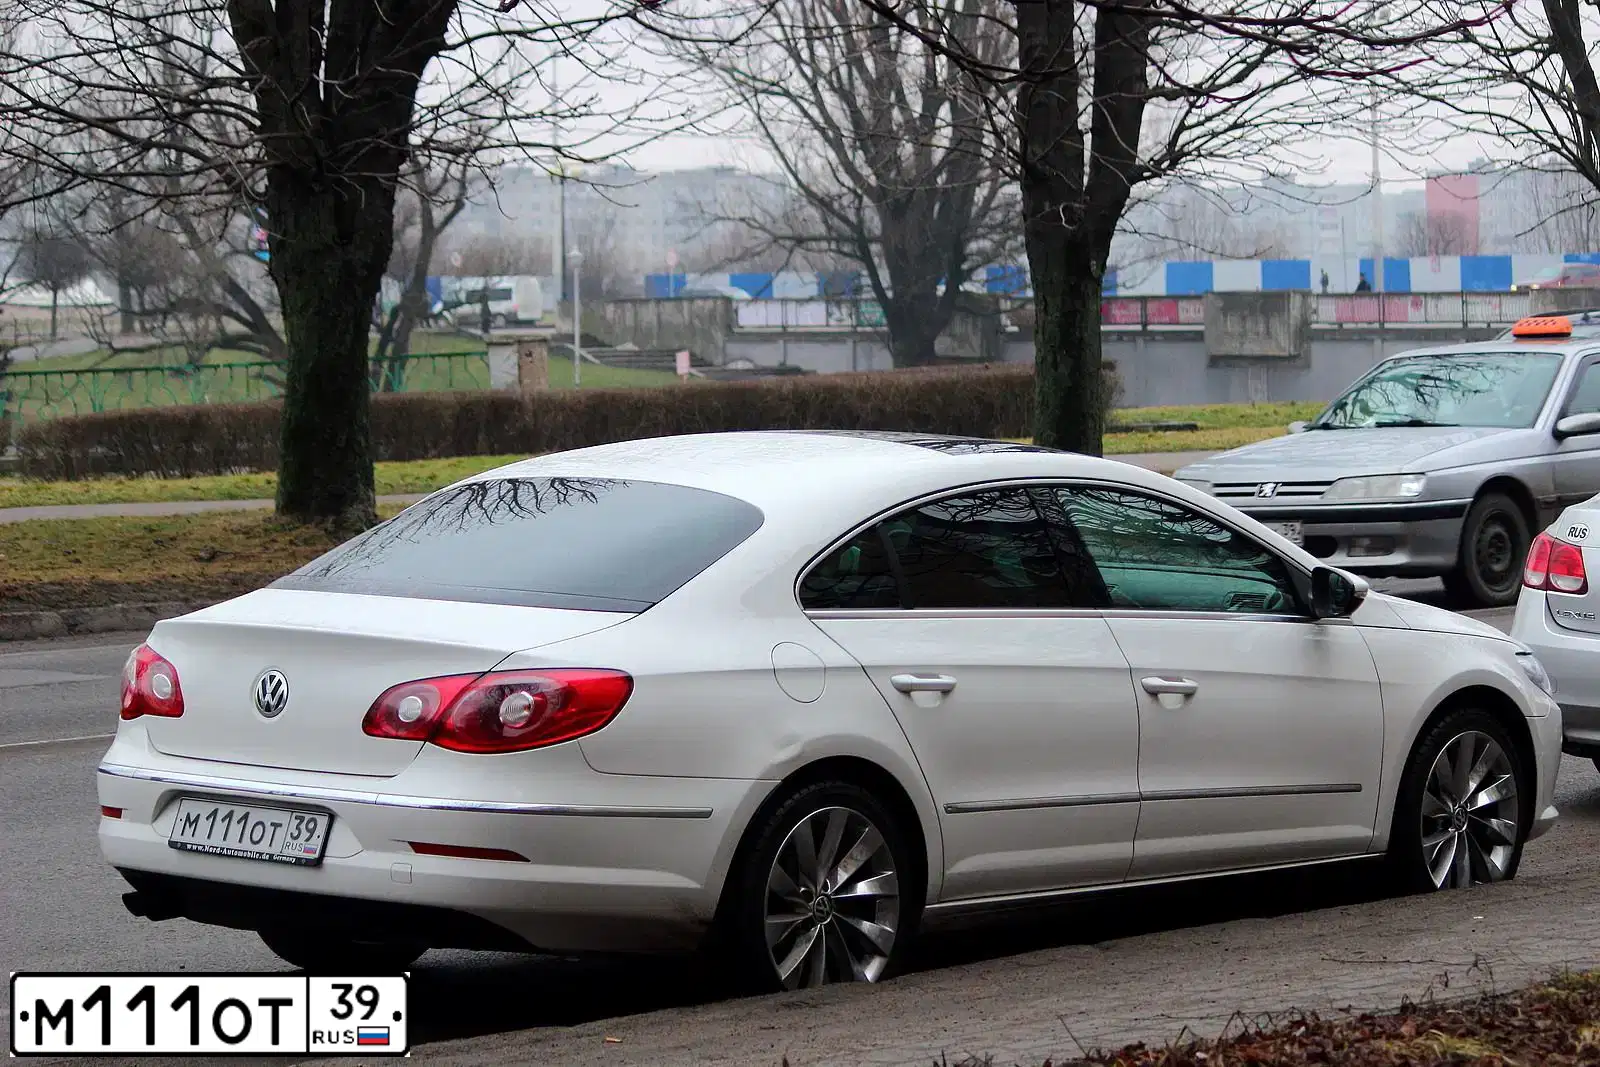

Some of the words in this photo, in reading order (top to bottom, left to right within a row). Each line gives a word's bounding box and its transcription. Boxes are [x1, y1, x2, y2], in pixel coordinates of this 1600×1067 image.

[1567, 526, 1588, 539] RUS
[290, 815, 318, 842] 39
[285, 842, 303, 852] RUS
[273, 855, 296, 864] Germany
